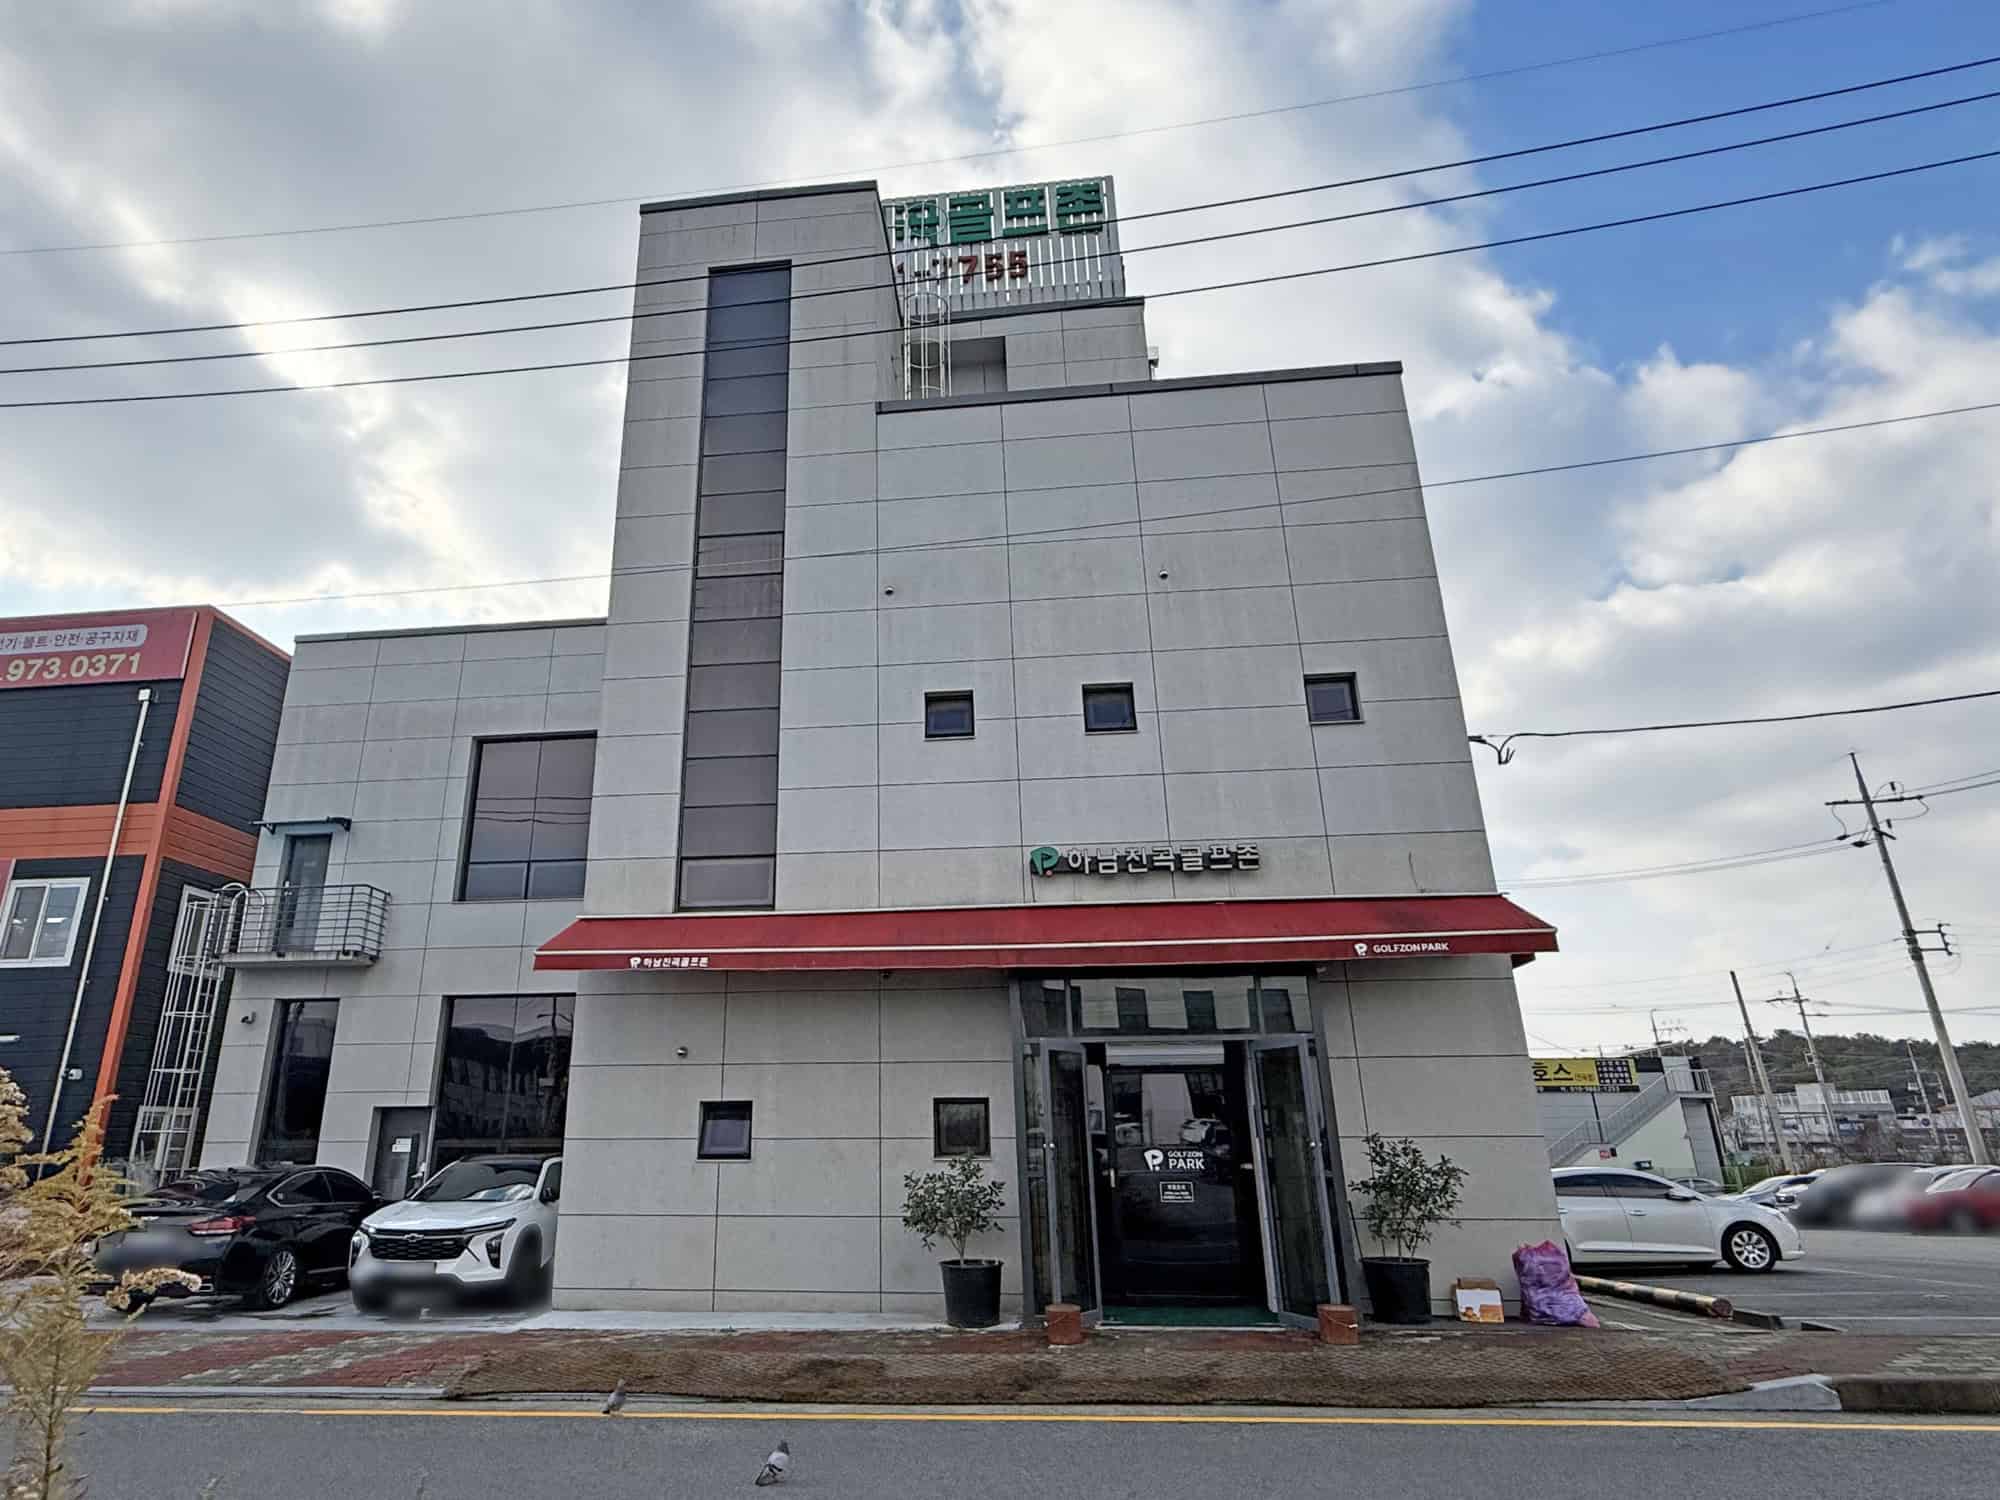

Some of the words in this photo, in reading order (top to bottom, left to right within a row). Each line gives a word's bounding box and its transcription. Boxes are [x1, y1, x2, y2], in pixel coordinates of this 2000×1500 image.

[1067, 843, 1261, 875] 하남진곡골프존
[1373, 944, 1420, 953] GOLFZON
[1421, 942, 1449, 951] PARK
[1167, 1150, 1204, 1158] GOLFZON
[1168, 1158, 1206, 1170] PARK
